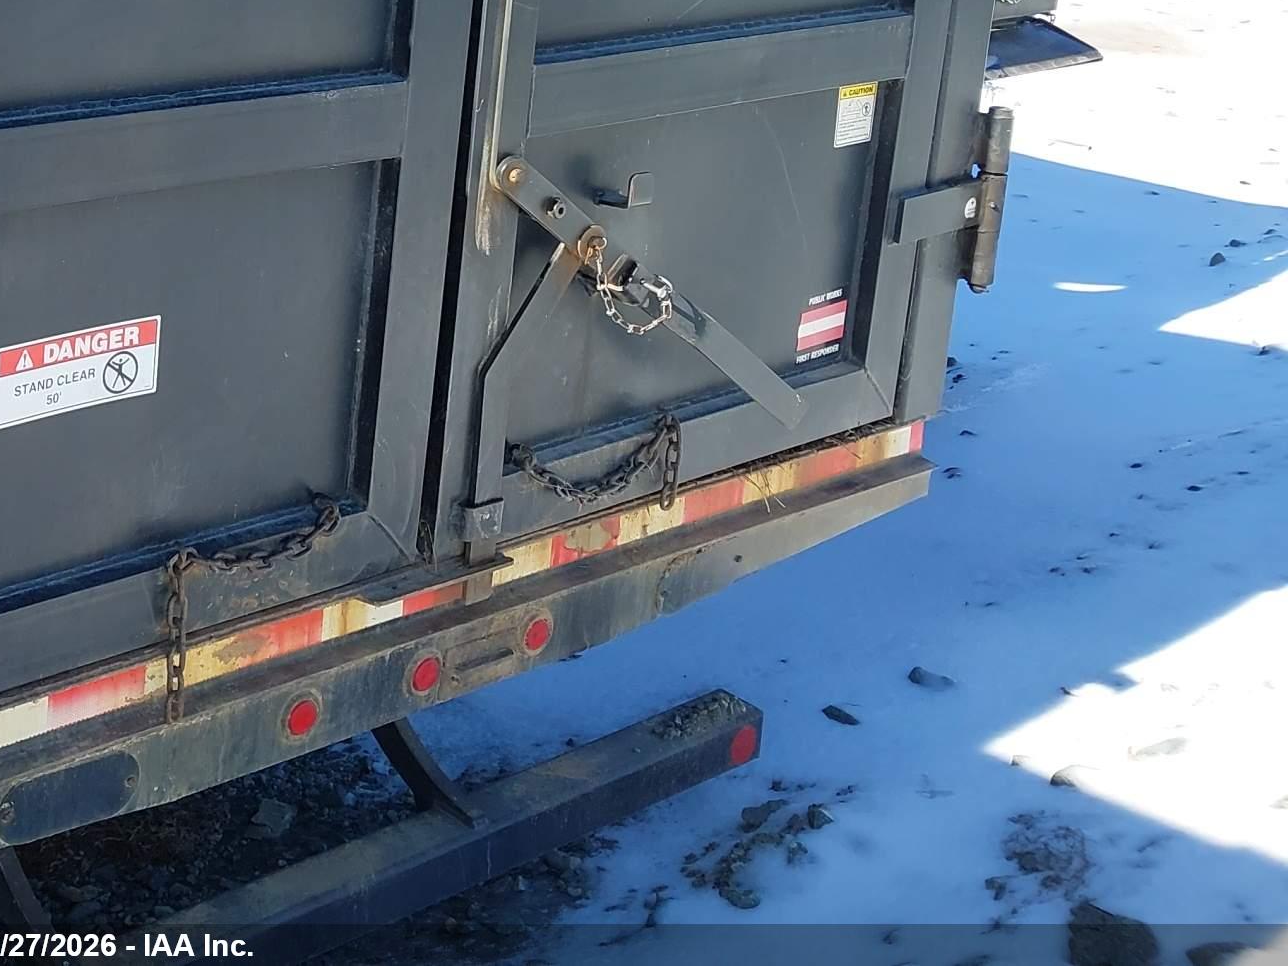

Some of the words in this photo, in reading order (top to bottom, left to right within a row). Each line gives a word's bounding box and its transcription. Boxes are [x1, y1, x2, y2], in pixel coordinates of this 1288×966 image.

[848, 85, 874, 96] CAUTION
[43, 325, 140, 364] DANGER
[796, 353, 811, 364] FIRST
[810, 343, 840, 360] RESPONDER
[13, 377, 54, 397] STAND
[56, 368, 96, 387] CLEAR
[46, 392, 62, 405] 50'
